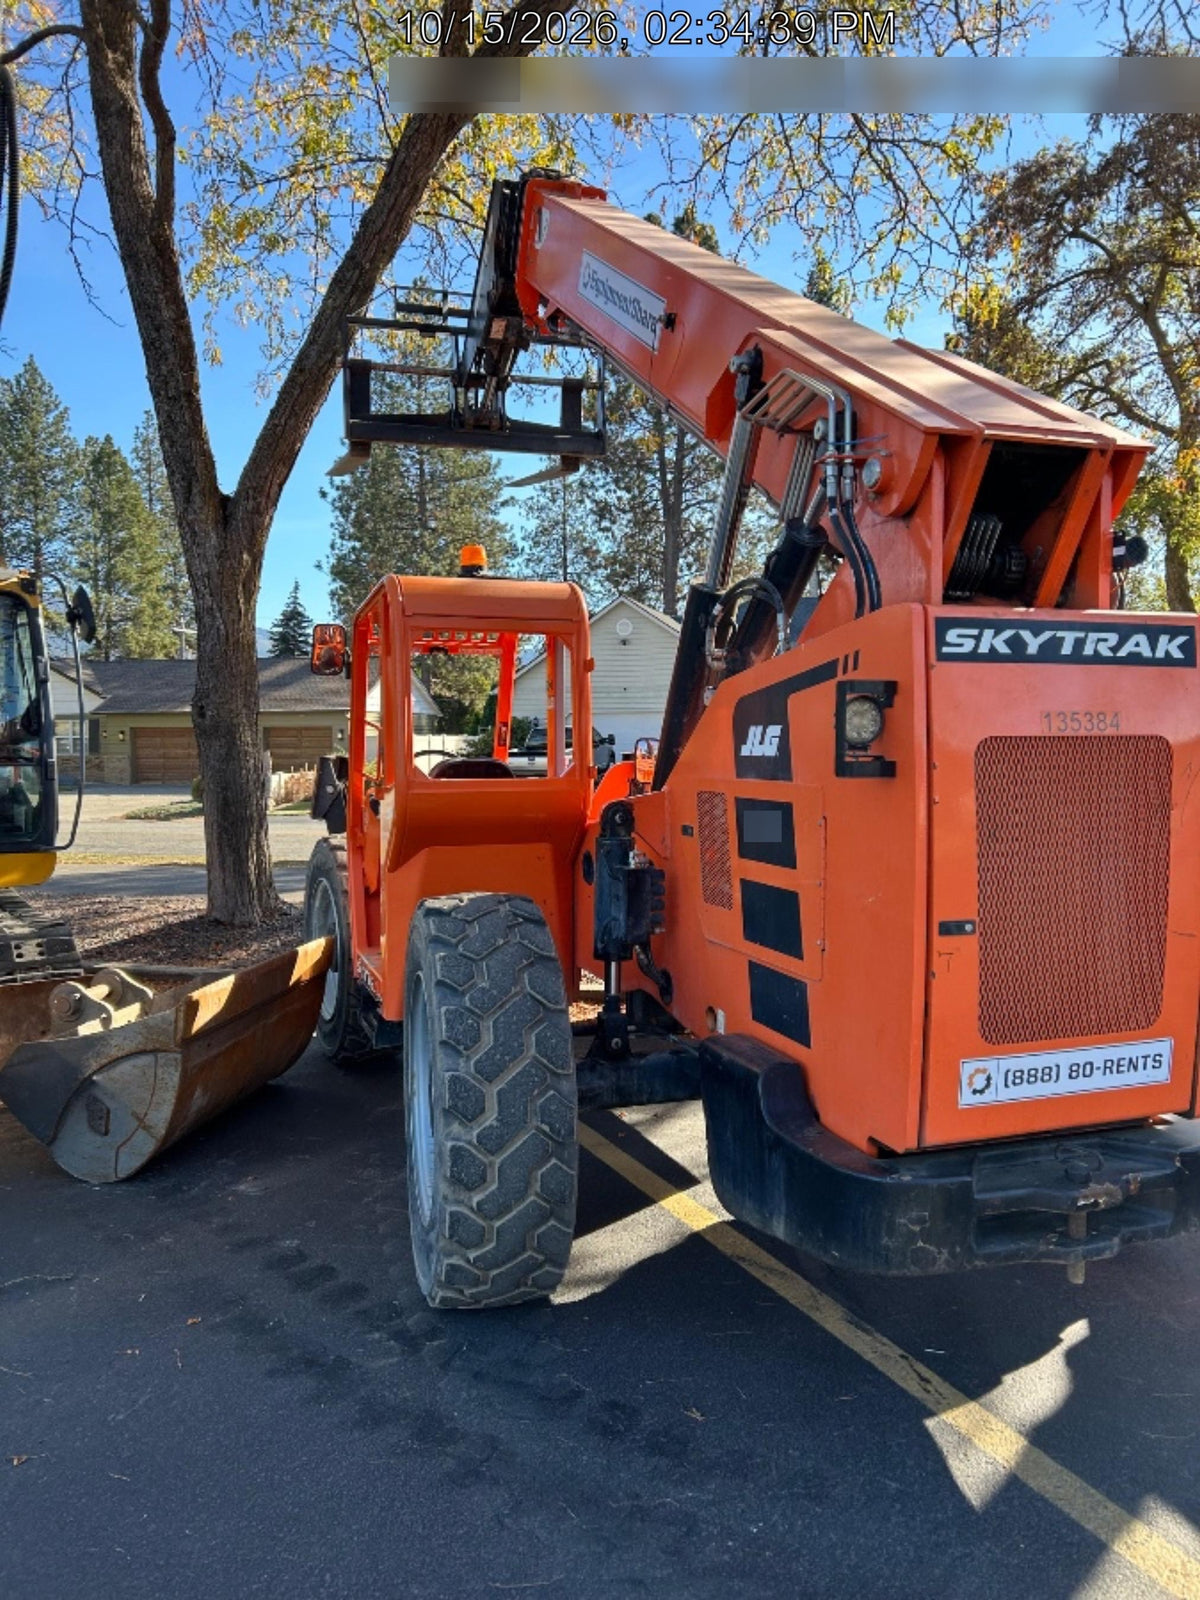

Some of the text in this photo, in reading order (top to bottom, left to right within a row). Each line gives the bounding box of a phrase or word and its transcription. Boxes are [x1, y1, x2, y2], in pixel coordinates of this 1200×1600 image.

[941, 628, 1190, 658] SKYTRAK
[1043, 712, 1121, 732] 135384
[740, 725, 782, 756] JLG
[1003, 1053, 1163, 1089] (888) 80-RENTS
